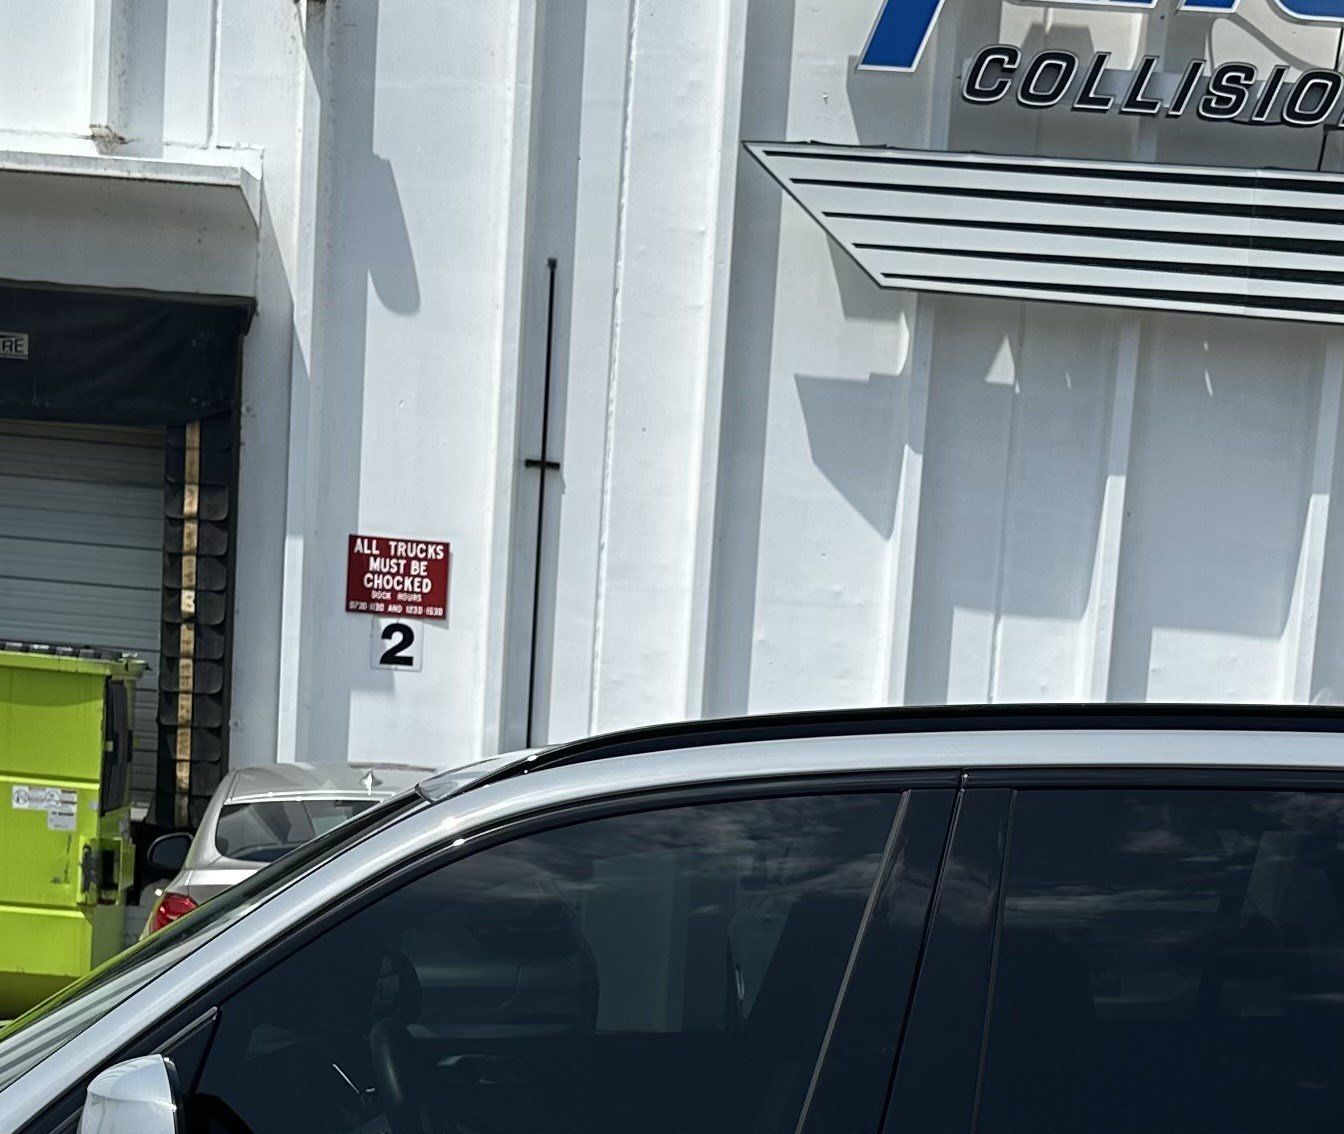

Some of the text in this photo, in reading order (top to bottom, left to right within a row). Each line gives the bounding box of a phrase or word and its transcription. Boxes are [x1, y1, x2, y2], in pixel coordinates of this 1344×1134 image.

[354, 538, 444, 560] ALL TRUCKS
[369, 556, 428, 576] MUST BE
[363, 573, 432, 593] CHOCKED
[371, 591, 392, 600] DOCK
[380, 622, 414, 666] 2
